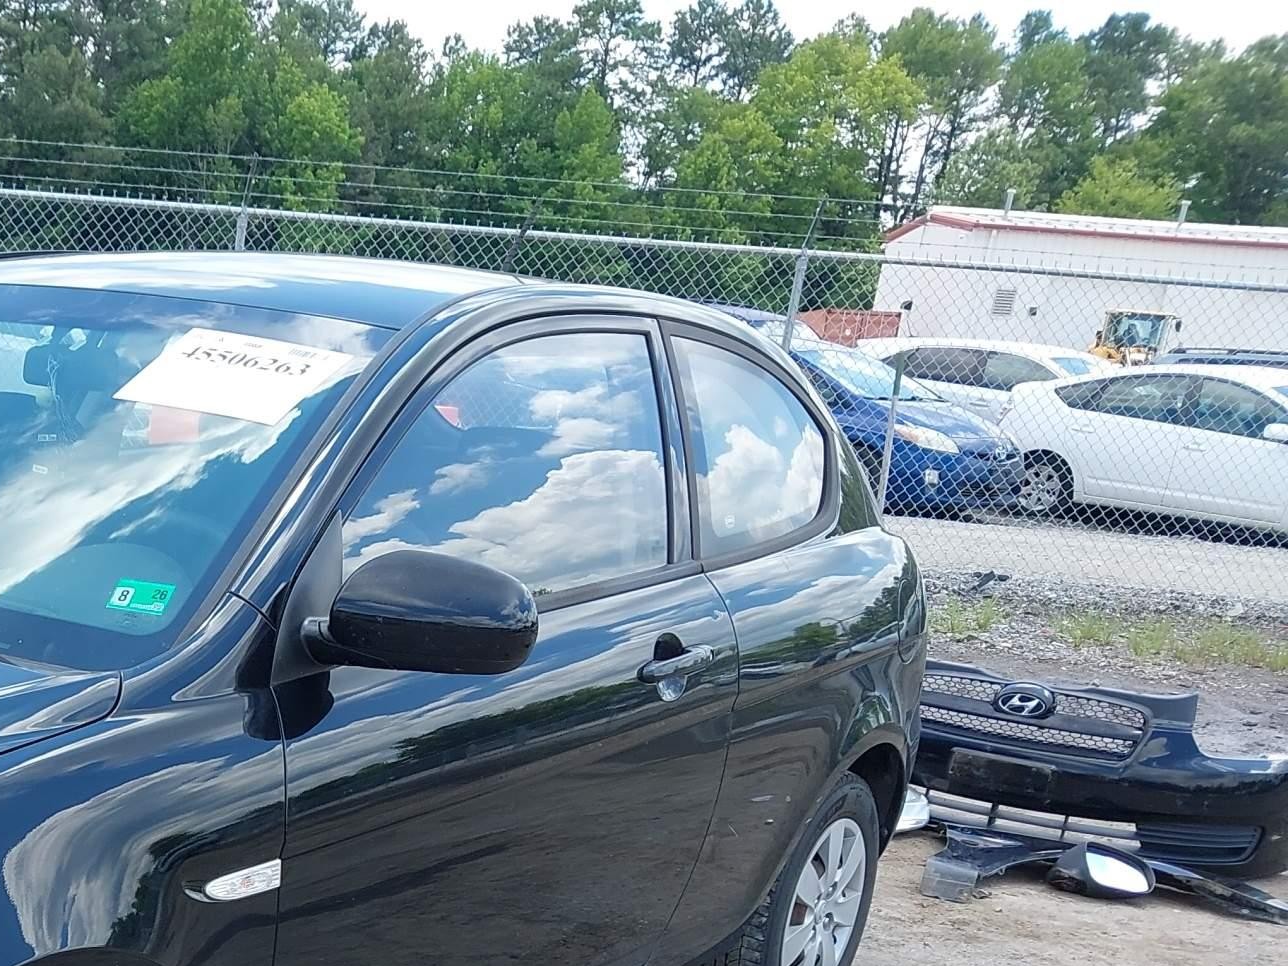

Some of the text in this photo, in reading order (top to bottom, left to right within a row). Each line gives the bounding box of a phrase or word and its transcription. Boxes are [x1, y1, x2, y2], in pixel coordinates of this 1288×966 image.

[182, 345, 312, 376] 45506263
[117, 589, 168, 602] 8 26
